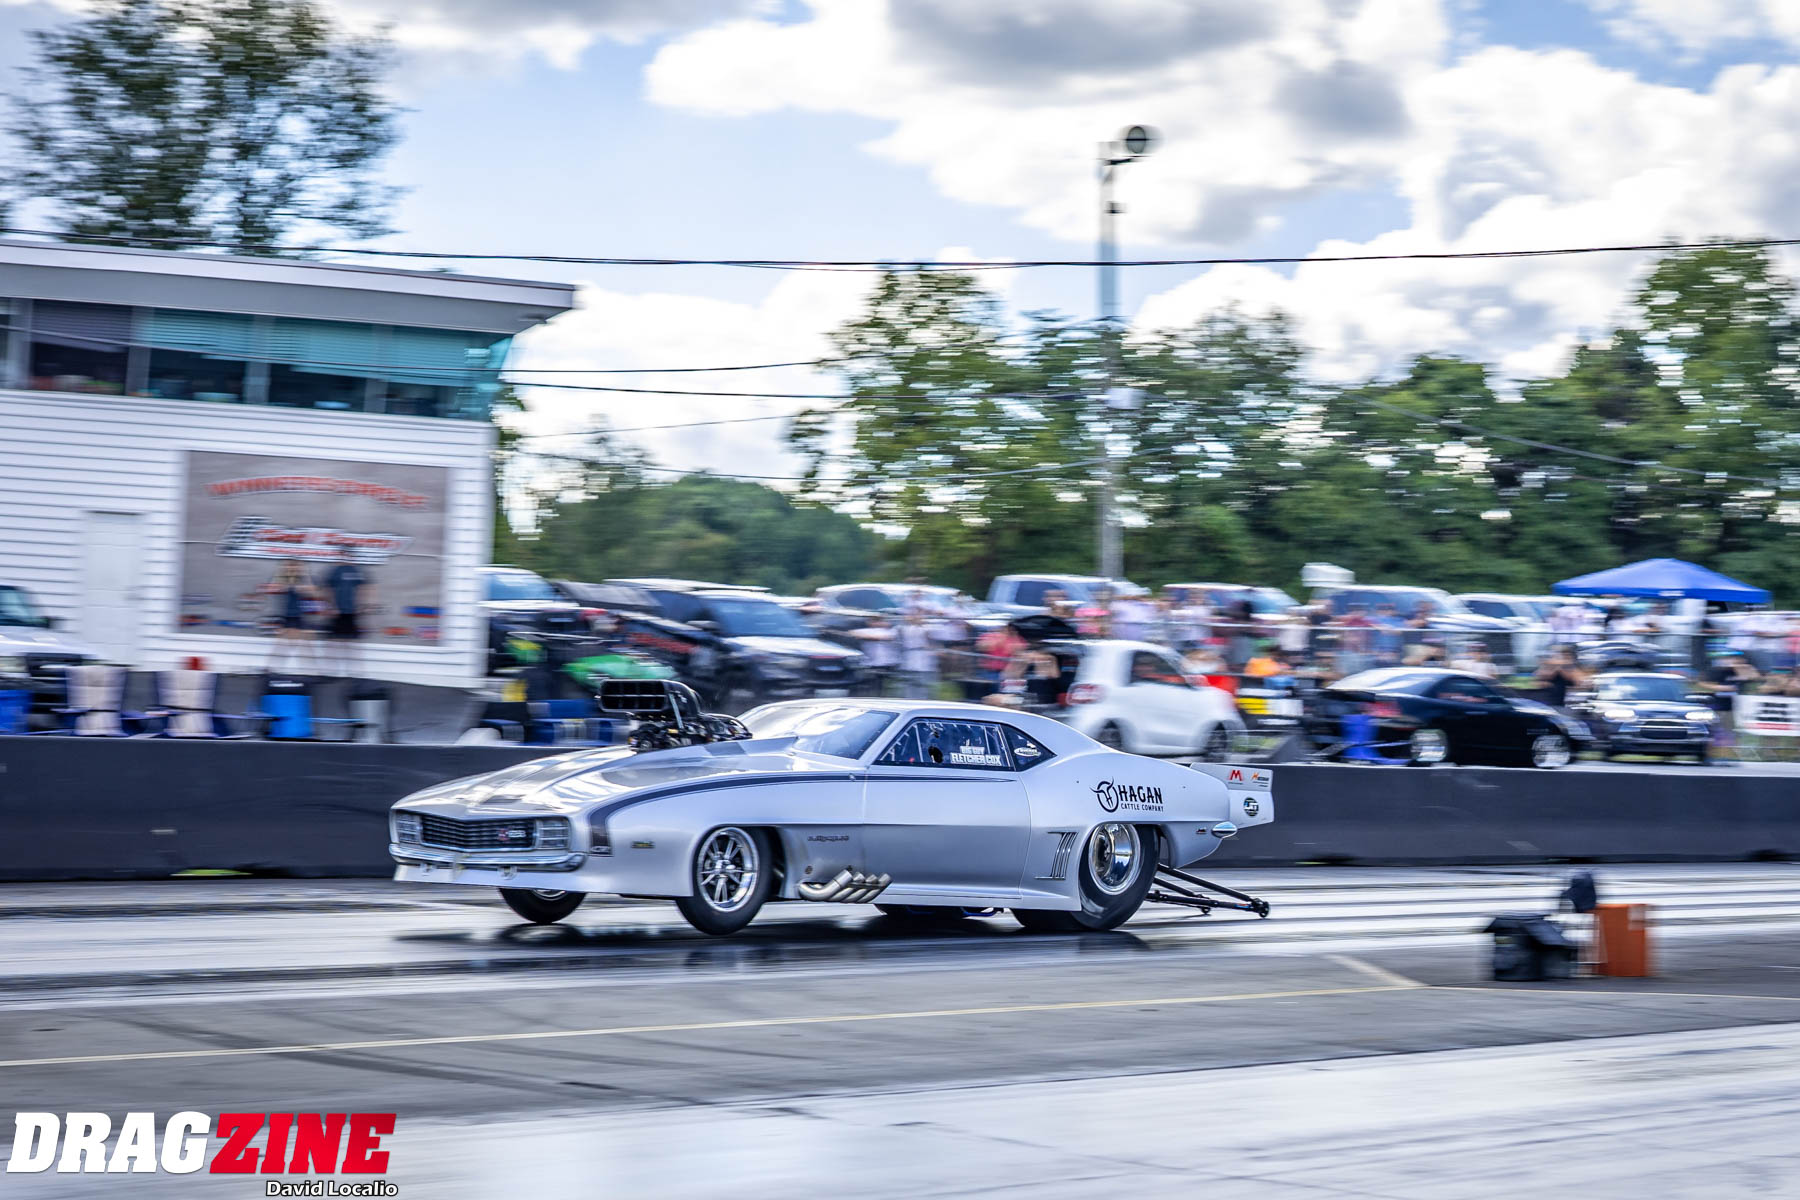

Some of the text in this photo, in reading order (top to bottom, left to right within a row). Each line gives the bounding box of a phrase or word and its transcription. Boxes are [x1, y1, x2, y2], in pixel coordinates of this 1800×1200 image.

[951, 753, 1001, 766] FLETCHER COX
[1117, 785, 1163, 804] HAGAN
[1121, 803, 1164, 812] CATTLE COMPANY
